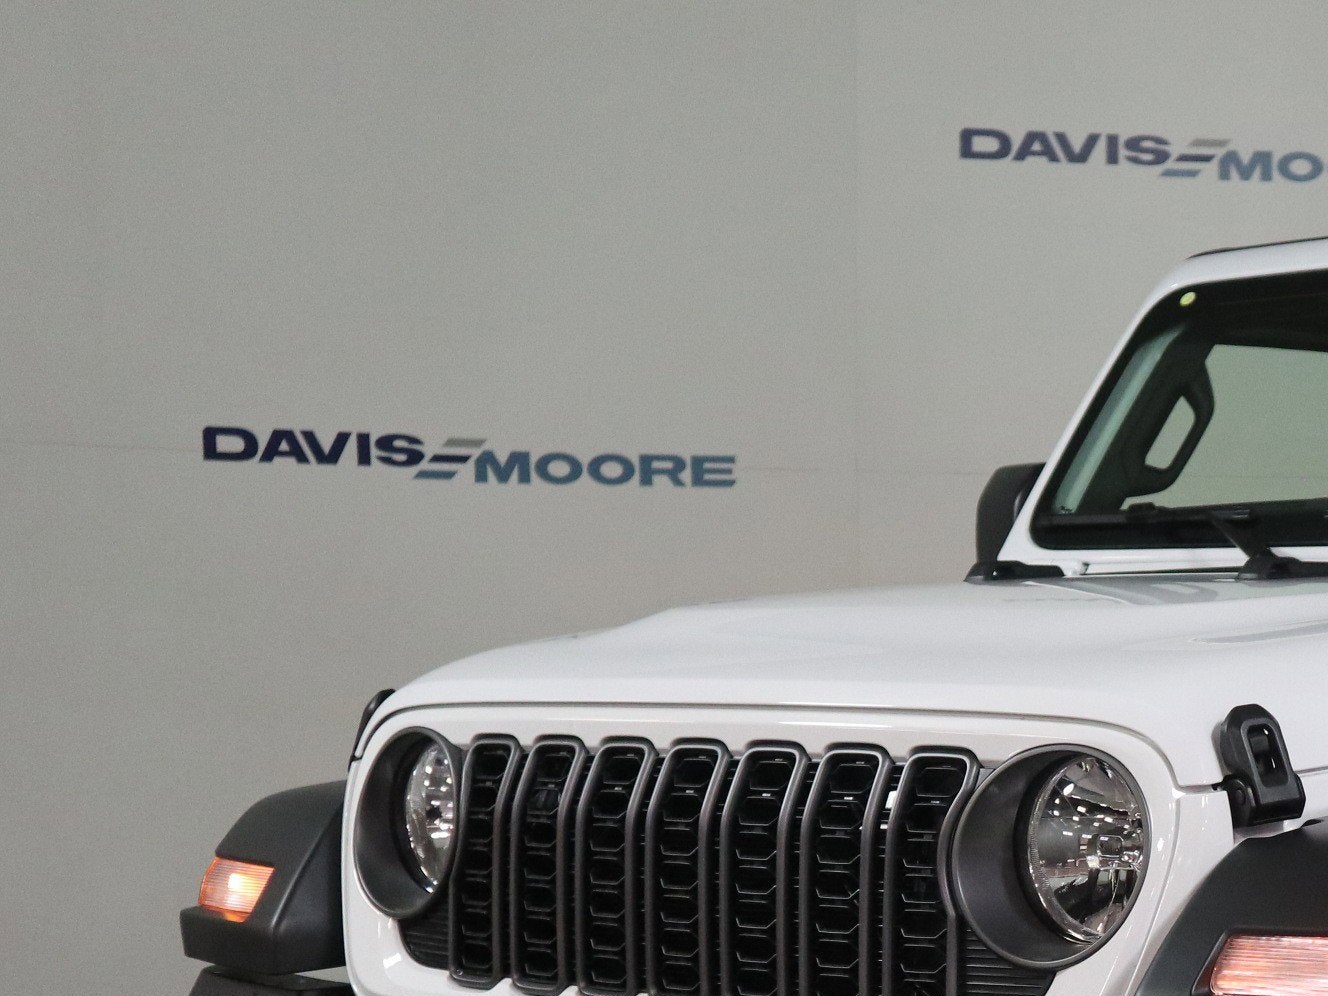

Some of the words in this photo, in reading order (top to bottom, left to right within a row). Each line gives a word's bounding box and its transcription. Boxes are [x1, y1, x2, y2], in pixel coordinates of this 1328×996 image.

[959, 127, 1172, 167] DAVIS
[201, 425, 427, 468] DAVIS
[473, 450, 737, 488] MOORE
